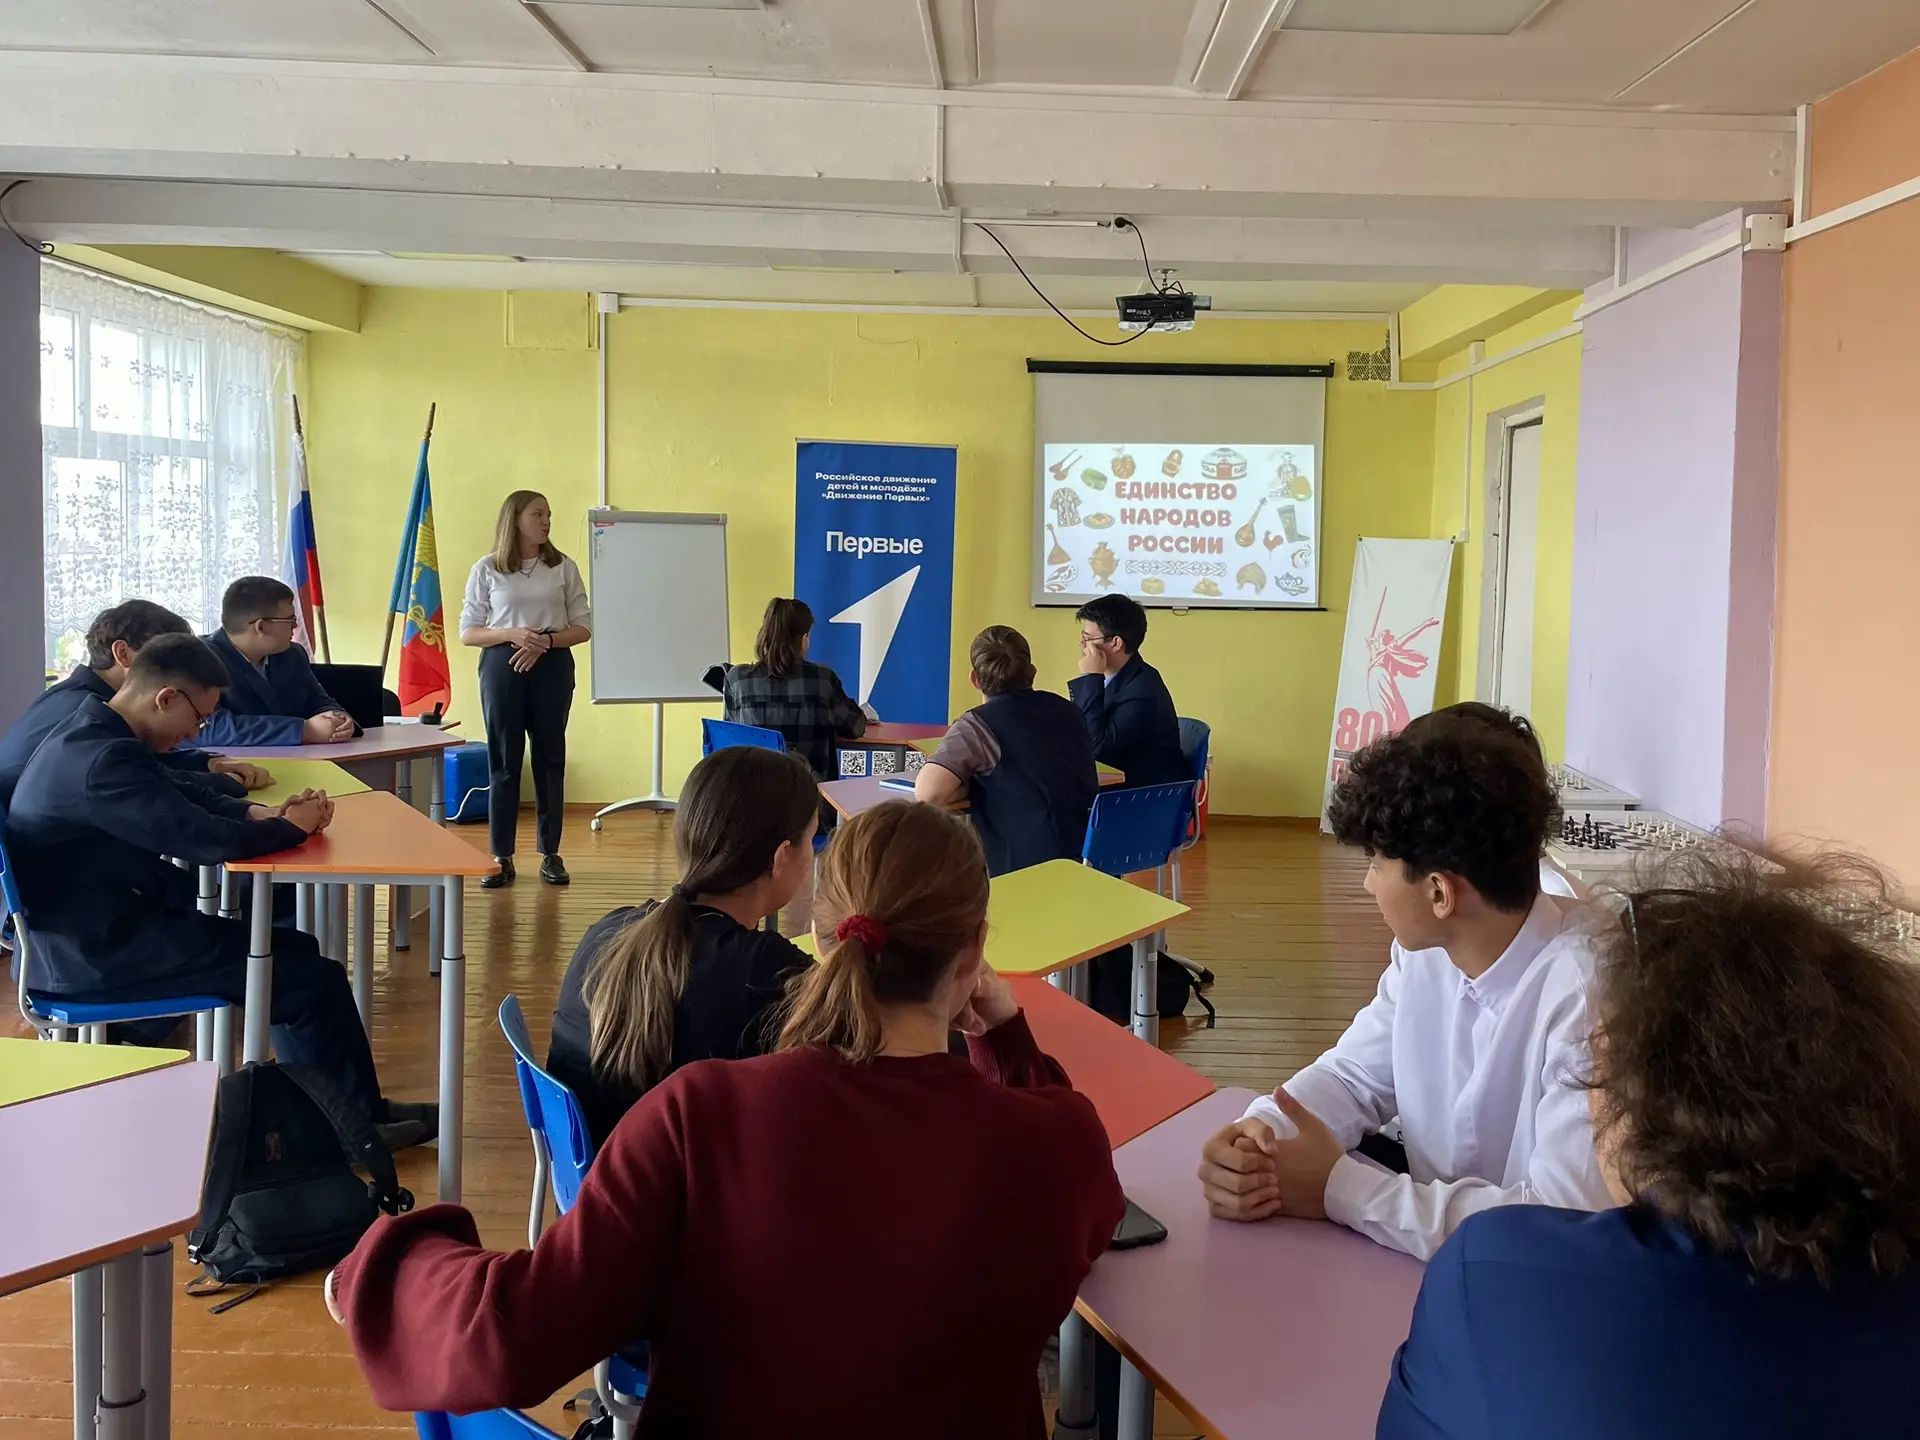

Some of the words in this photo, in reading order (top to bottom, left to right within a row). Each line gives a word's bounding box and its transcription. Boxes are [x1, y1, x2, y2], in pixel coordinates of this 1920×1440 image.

[815, 472, 881, 482] Российское
[882, 476, 937, 484] движение
[821, 491, 883, 500] «Движение
[884, 493, 930, 502] Первых»
[827, 483, 859, 491] детей
[869, 484, 926, 493] молодёжи
[1115, 481, 1237, 500] ЕДИНСТВО
[1120, 507, 1231, 528] НАРОДОВ
[826, 530, 924, 559] Первые
[1128, 535, 1224, 555] РОССИИ
[1335, 707, 1384, 751] 80
